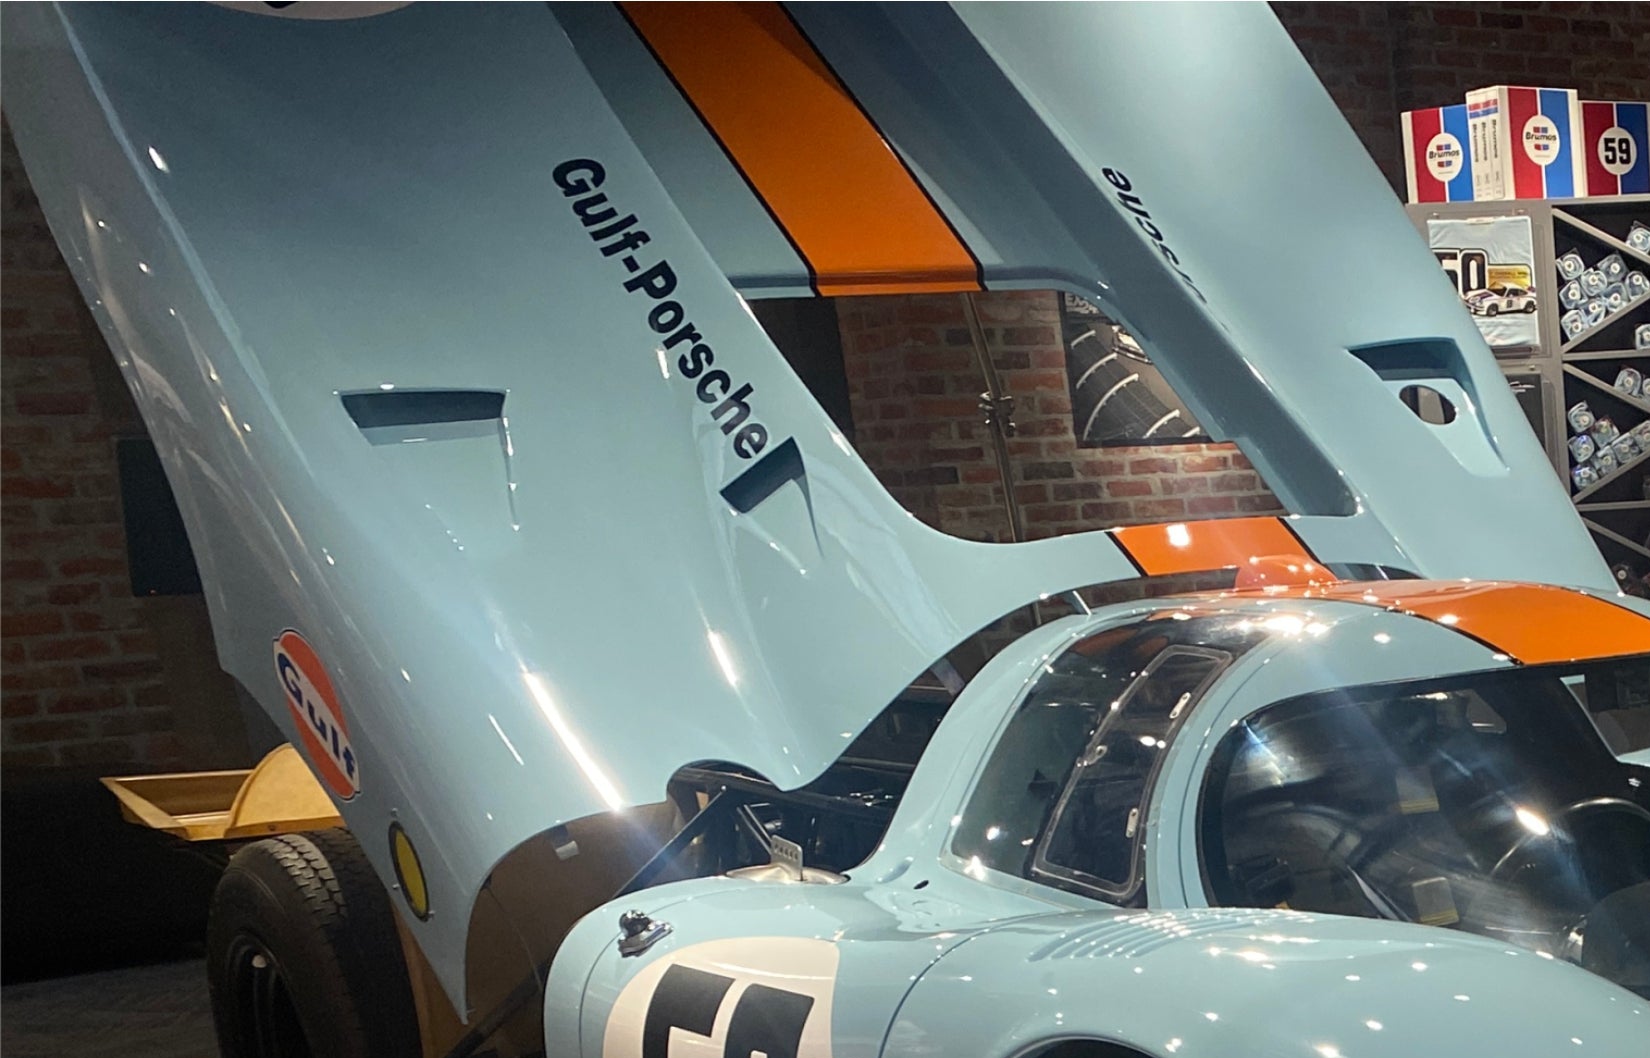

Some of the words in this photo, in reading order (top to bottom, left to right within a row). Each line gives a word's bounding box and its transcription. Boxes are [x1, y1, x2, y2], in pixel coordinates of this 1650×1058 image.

[1525, 131, 1557, 141] Brumos
[1428, 150, 1460, 159] Brumos
[1603, 137, 1632, 165] 59
[552, 158, 769, 460] Gulf-Porsche
[277, 652, 356, 780] Gulf
